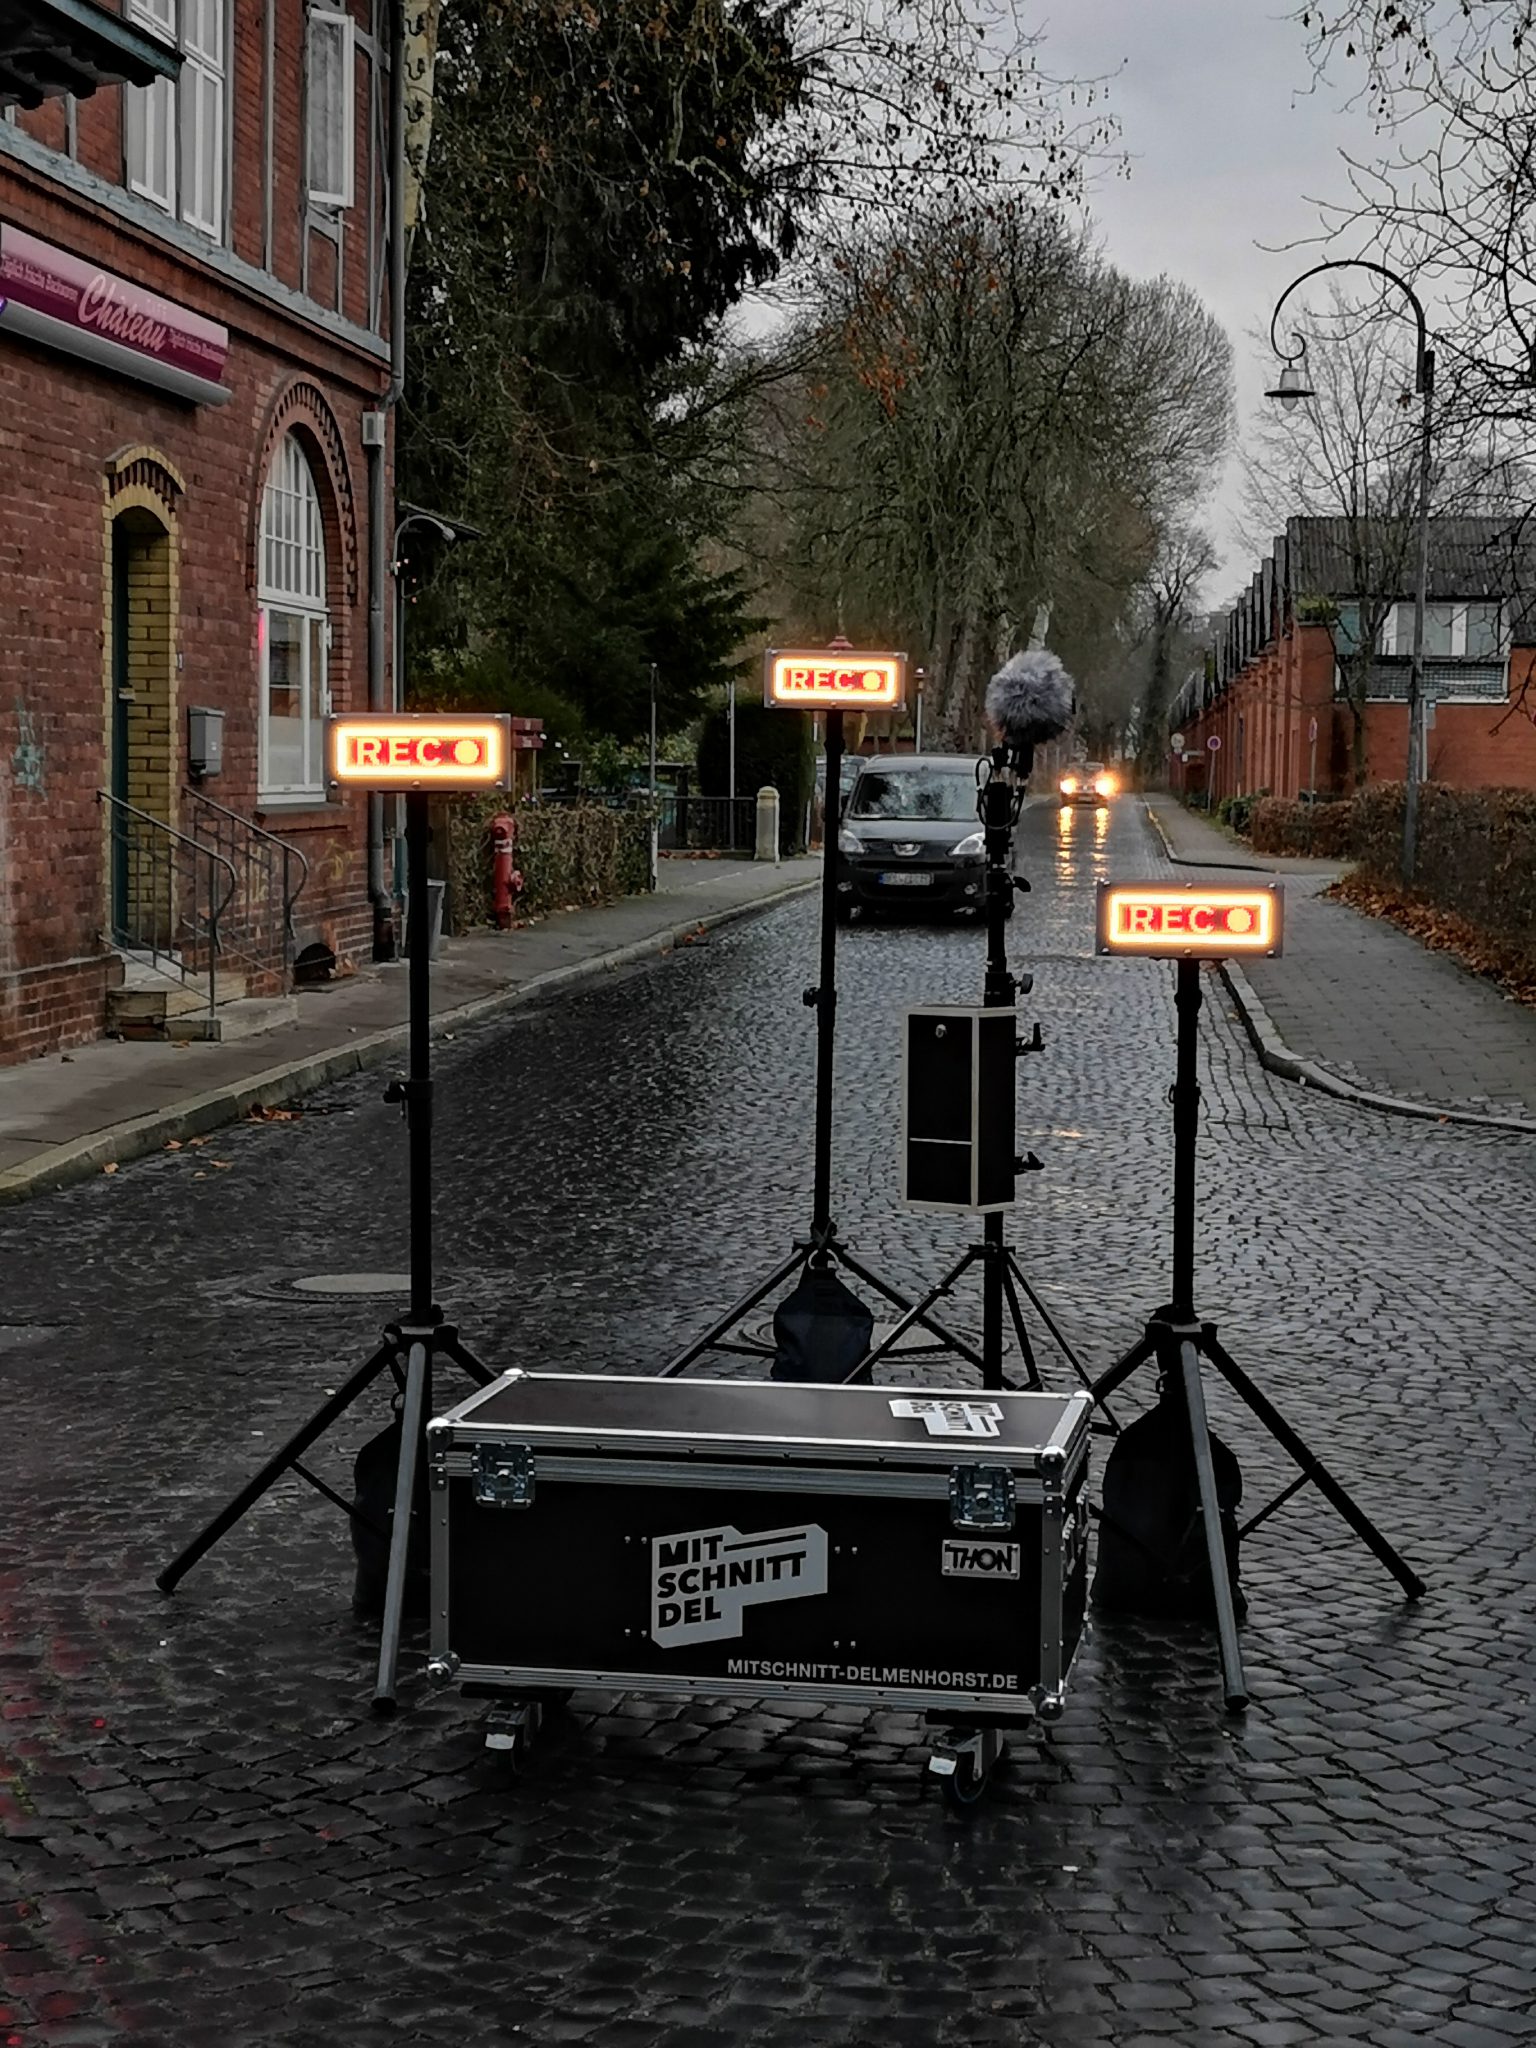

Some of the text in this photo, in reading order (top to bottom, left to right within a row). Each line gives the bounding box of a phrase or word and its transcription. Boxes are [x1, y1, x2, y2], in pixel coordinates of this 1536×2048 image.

[790, 669, 855, 691] REC
[356, 737, 442, 767] REC
[1128, 904, 1215, 934] REC
[658, 1534, 724, 1569] MIT
[944, 1544, 1013, 1572] THON
[656, 1551, 807, 1599] SCHNITT
[658, 1595, 722, 1629] DEL
[727, 1658, 1019, 1690] MITSCHNITT-DELMENHORST.DE
